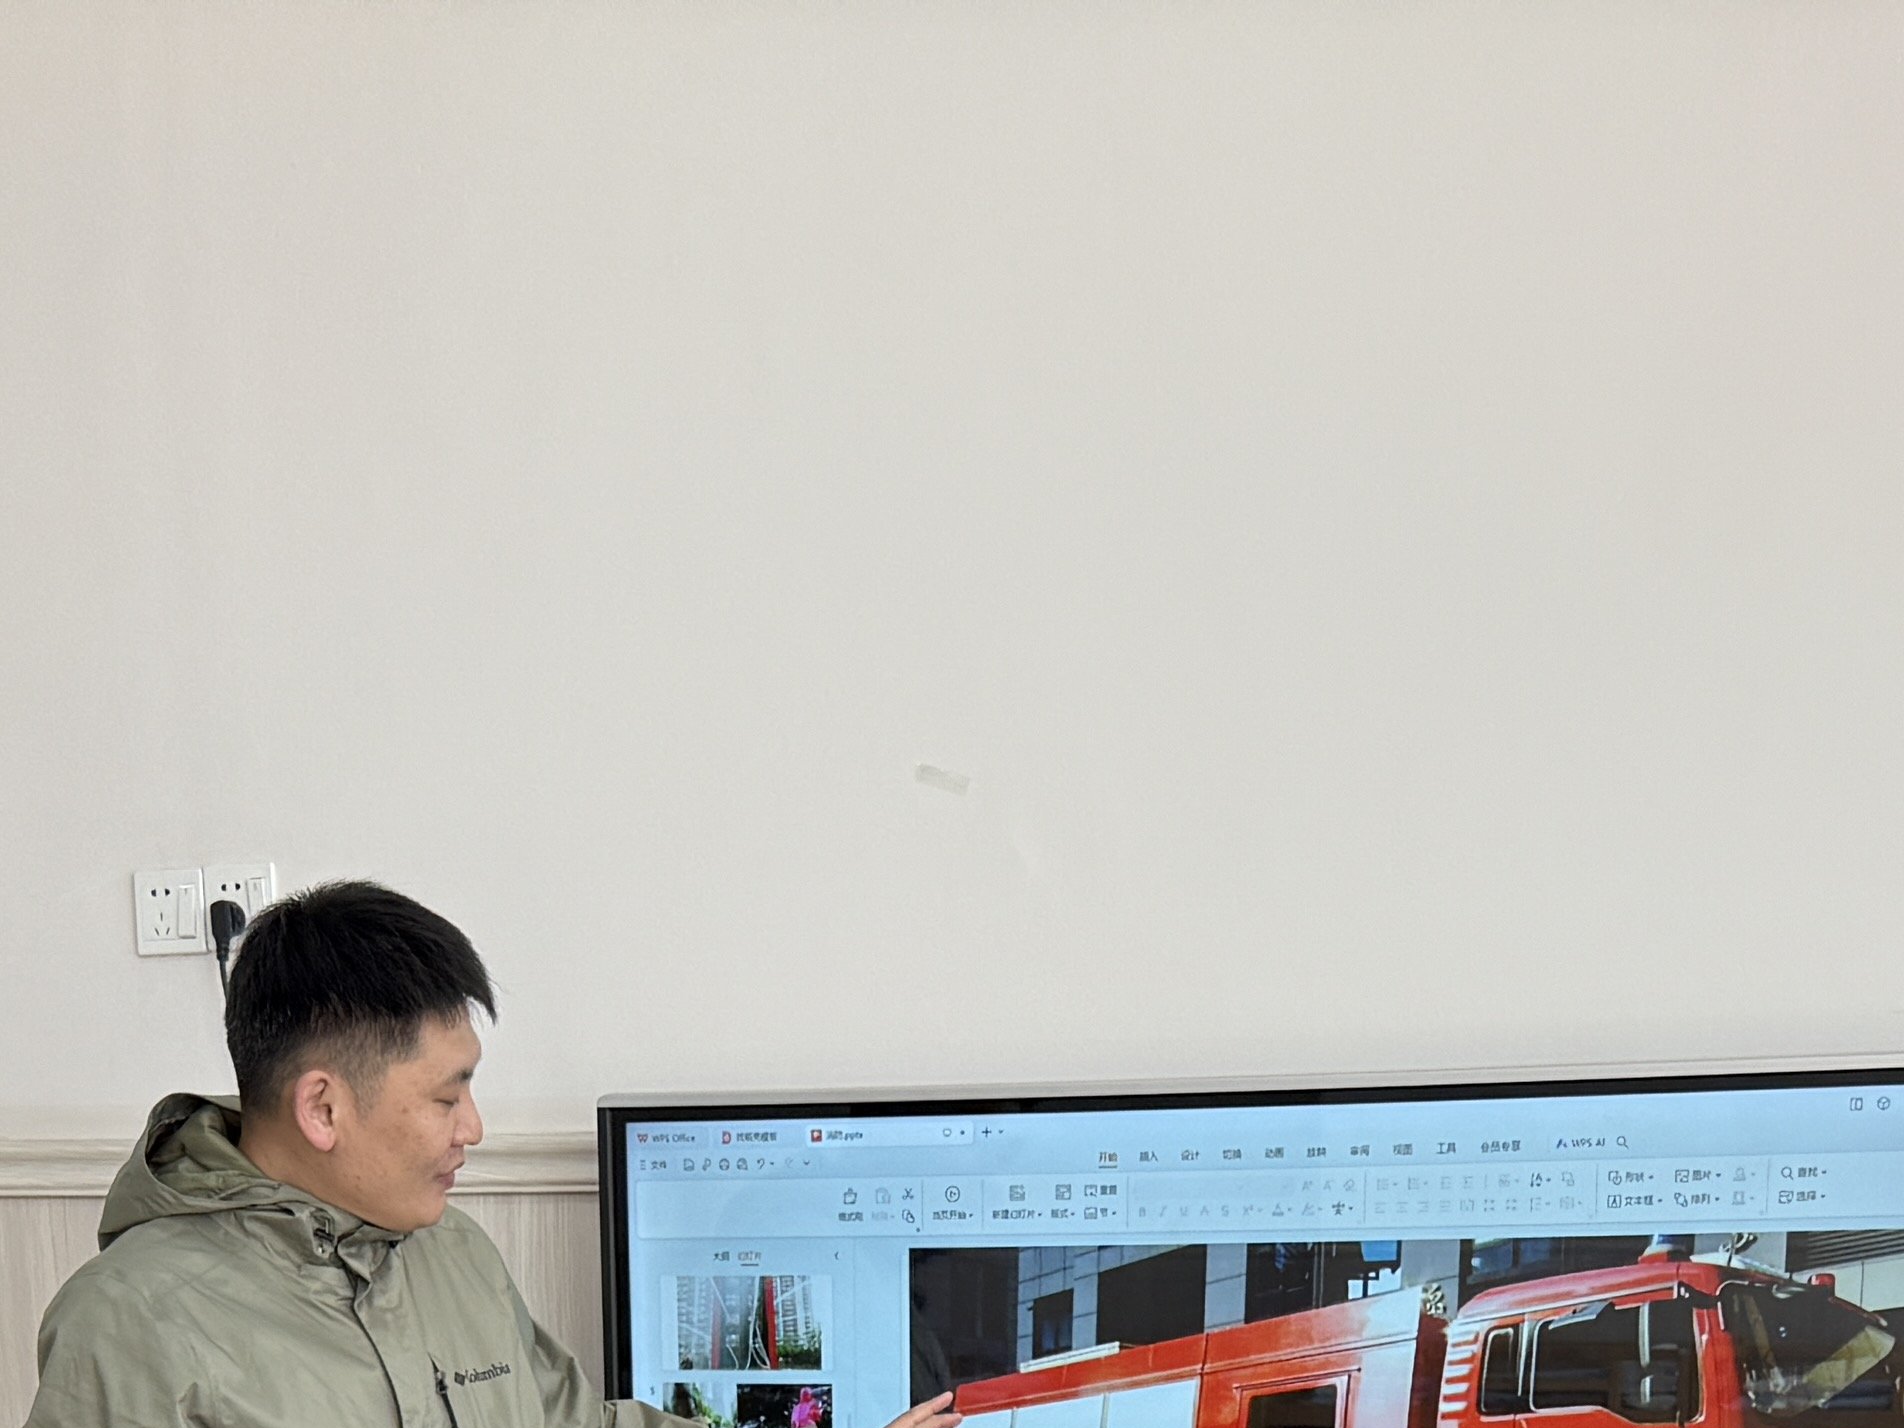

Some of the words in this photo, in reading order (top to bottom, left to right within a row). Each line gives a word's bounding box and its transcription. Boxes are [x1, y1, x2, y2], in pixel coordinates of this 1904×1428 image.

[672, 1134, 696, 1143] Office
[1436, 1141, 1457, 1154] 工具
[1099, 1151, 1118, 1163] 开始
[1180, 1149, 1200, 1161] 设计
